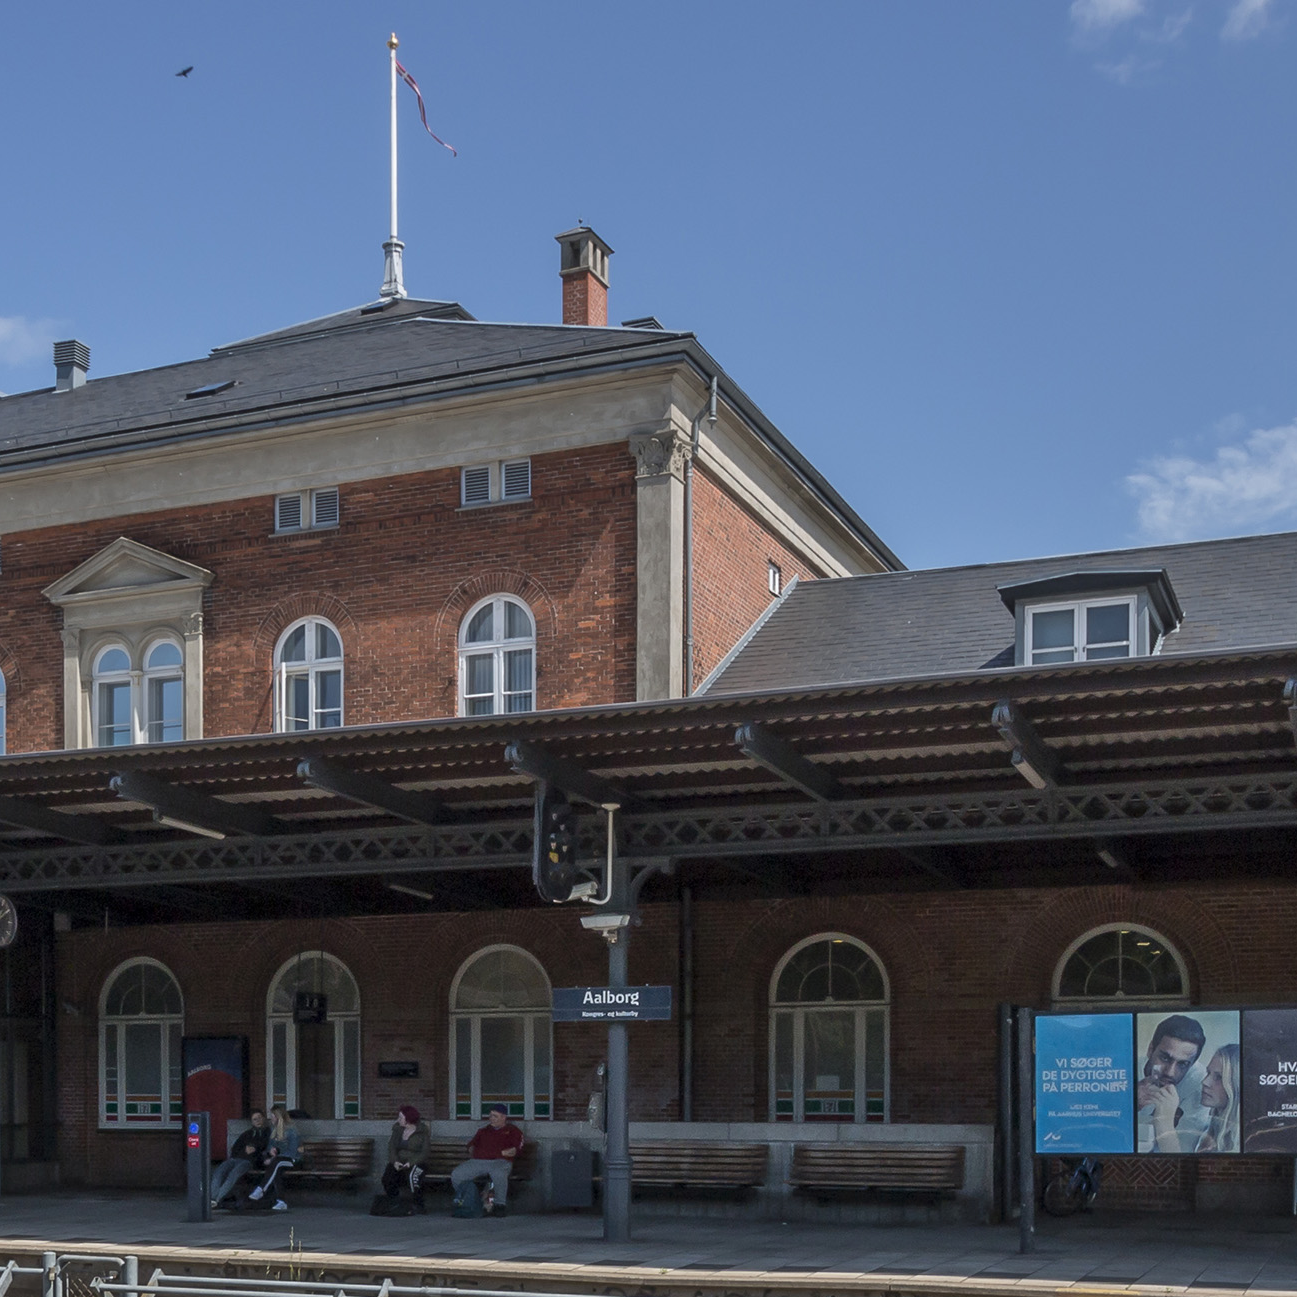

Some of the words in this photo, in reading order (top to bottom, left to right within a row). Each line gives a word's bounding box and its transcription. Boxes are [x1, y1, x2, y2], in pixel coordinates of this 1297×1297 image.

[583, 990, 640, 1006] Aalborg
[1056, 1058, 1067, 1068] VI
[1070, 1057, 1112, 1068] SØGER
[1043, 1070, 1057, 1080] DE
[1061, 1069, 1126, 1080] DYGTIGSTE
[1043, 1081, 1058, 1092] PÅ
